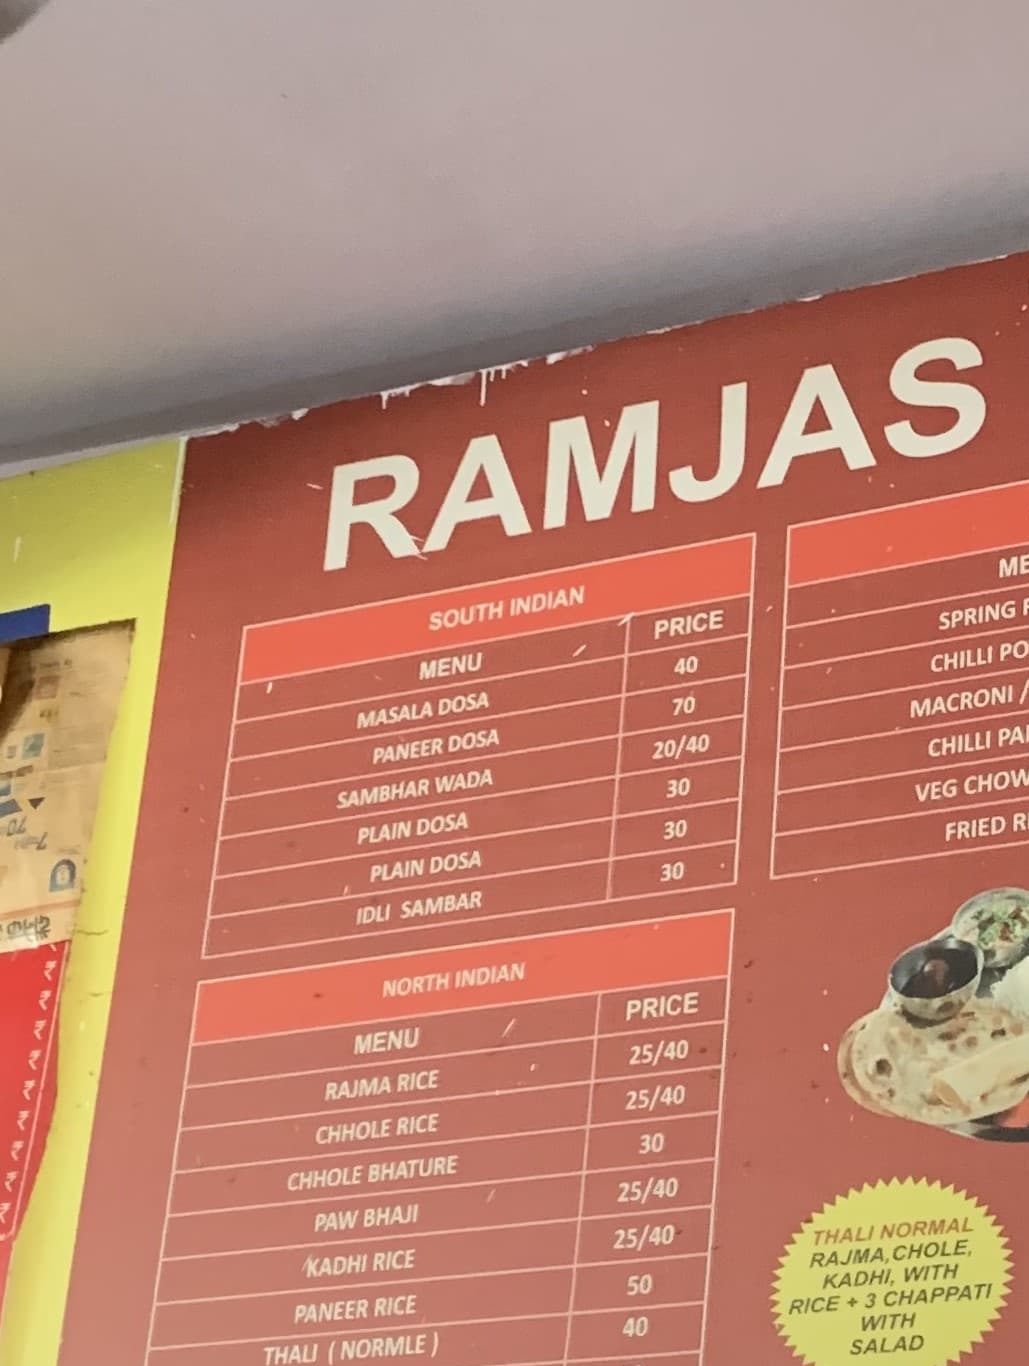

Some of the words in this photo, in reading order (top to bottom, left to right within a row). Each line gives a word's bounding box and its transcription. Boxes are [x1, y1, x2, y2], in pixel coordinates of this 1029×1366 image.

[324, 338, 985, 570] RAMJAS
[429, 601, 503, 630] SOUTH
[510, 586, 584, 616] INDIAN
[939, 601, 1015, 629] SPRING
[655, 610, 723, 639] PRICE
[420, 653, 482, 680] MENU
[675, 656, 698, 674] 40
[931, 646, 992, 672] CHILLI
[357, 702, 433, 728] MASALA
[439, 692, 489, 715] DOSA
[673, 696, 695, 715] 70
[911, 685, 1012, 718] MACRONI
[373, 738, 443, 764] PANEER
[448, 729, 499, 752] DOSA
[653, 735, 709, 759] 20/40
[929, 731, 990, 756] CHILLI
[337, 779, 429, 808] SAMBHAR
[435, 769, 493, 793] WADA
[667, 778, 690, 797] 30
[915, 779, 957, 801] VEG
[358, 821, 411, 844] PLAIN
[417, 812, 468, 835] DOSA
[664, 820, 687, 839] 30
[946, 816, 1006, 841] FRIED
[371, 859, 424, 882] PLAIN
[430, 851, 481, 873] DOSA
[661, 862, 684, 881] 30
[357, 904, 390, 924] IDLI
[400, 891, 482, 918] SAMBAR
[383, 973, 449, 997] NORTH
[455, 963, 524, 987] INDIAN
[626, 992, 698, 1020] PRICE
[355, 1028, 419, 1054] MENU
[630, 1040, 688, 1066] 25/40
[325, 1077, 391, 1100] RAJMA
[397, 1070, 439, 1091] RICE
[626, 1085, 685, 1111] 25/40
[316, 1119, 391, 1144] CHHOLE
[397, 1114, 438, 1135] RICE
[640, 1133, 664, 1154] 30
[288, 1166, 363, 1190] CHHOLE
[368, 1155, 458, 1182] BHATURE
[618, 1178, 678, 1204] 25/40
[315, 1210, 358, 1232] PAW
[364, 1204, 418, 1227] BHAJI
[814, 1226, 874, 1246] THALI
[880, 1217, 973, 1239] NORMAL
[614, 1225, 674, 1251] 25/40
[304, 1254, 367, 1277] KADHI
[373, 1249, 415, 1271] RICE
[823, 1269, 894, 1289] KADHI,
[905, 1264, 958, 1282] WITH
[628, 1275, 652, 1295] 50
[295, 1299, 368, 1323] PANEER
[374, 1295, 416, 1316] RICE
[789, 1296, 840, 1315] RICE
[865, 1293, 876, 1308] 3
[884, 1284, 992, 1306] CHAPPATI
[623, 1317, 648, 1337] 40
[862, 1312, 916, 1331] WITH
[264, 1344, 317, 1365] THALI
[341, 1334, 426, 1360] NORMLE
[850, 1335, 924, 1355] SALAD
